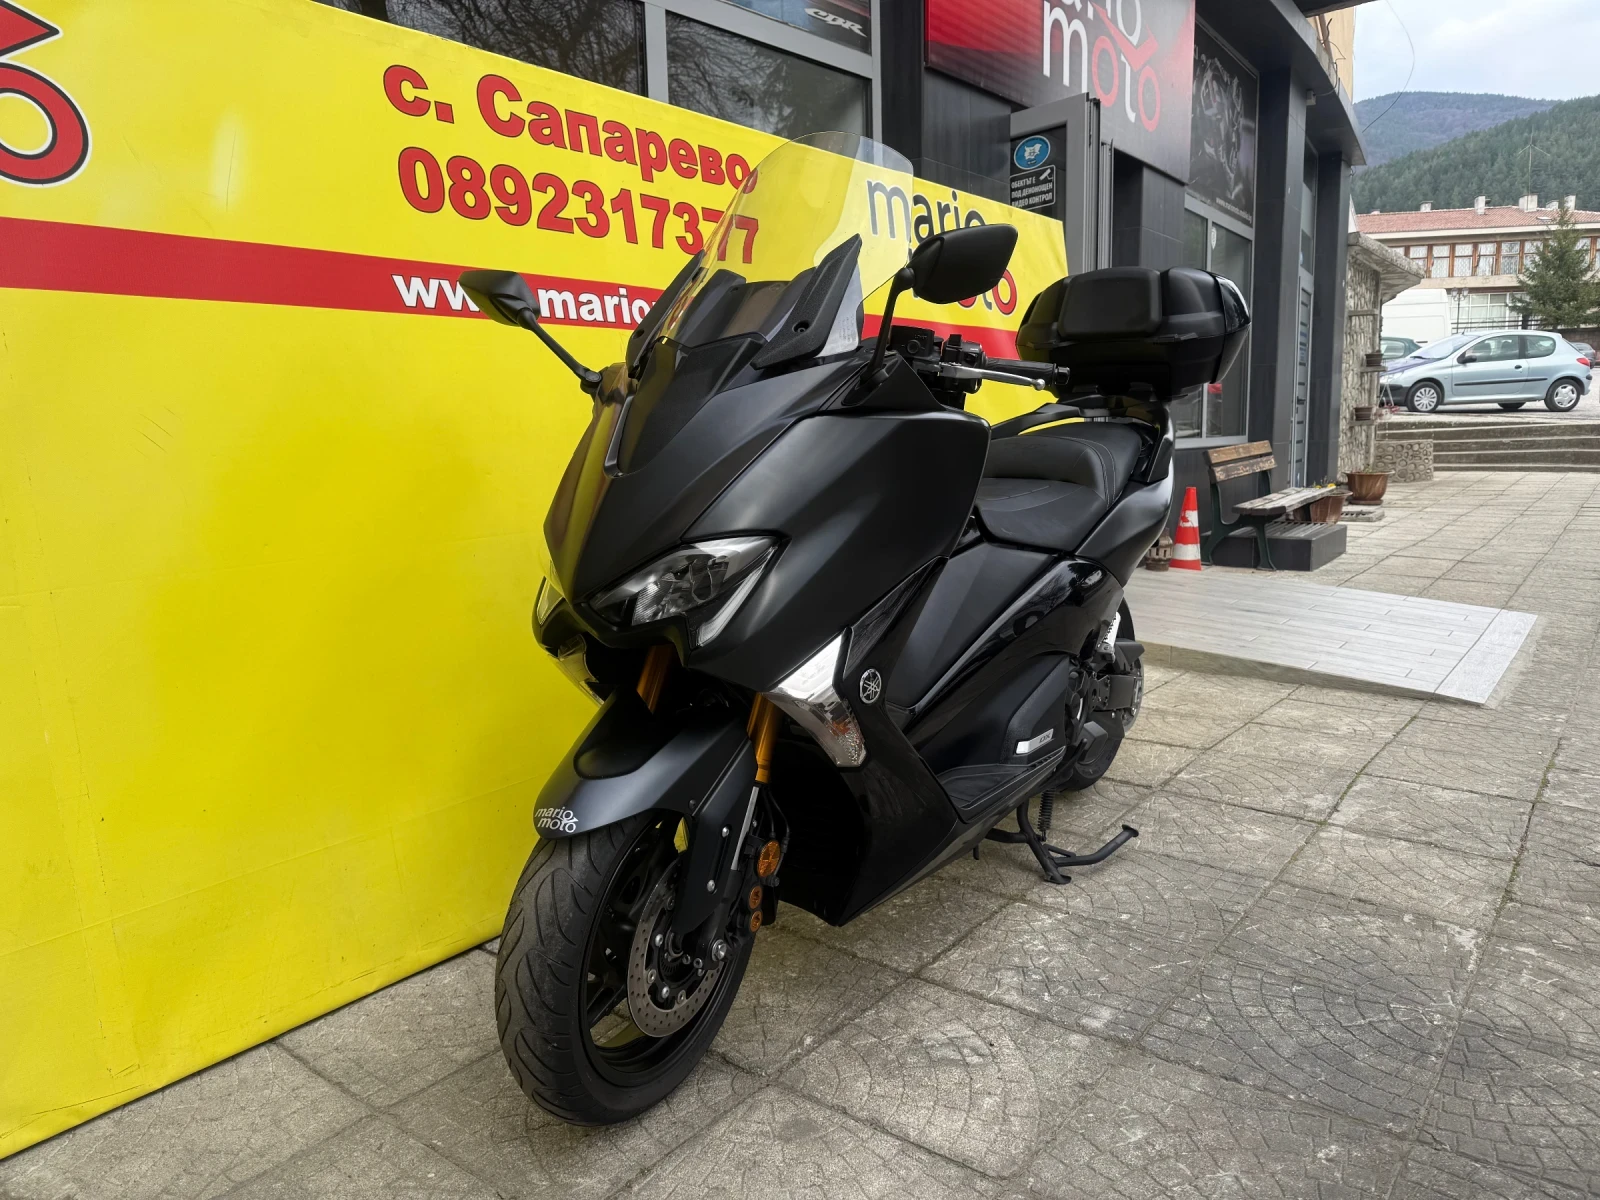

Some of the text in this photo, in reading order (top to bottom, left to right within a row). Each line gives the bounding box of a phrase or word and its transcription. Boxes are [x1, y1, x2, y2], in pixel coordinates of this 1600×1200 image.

[804, 8, 867, 37] CBR
[1043, 0, 1161, 132] moto
[383, 64, 759, 194] с. Сапарево
[398, 147, 759, 264] 0892317377
[534, 806, 574, 820] mario
[537, 817, 577, 833] moto
